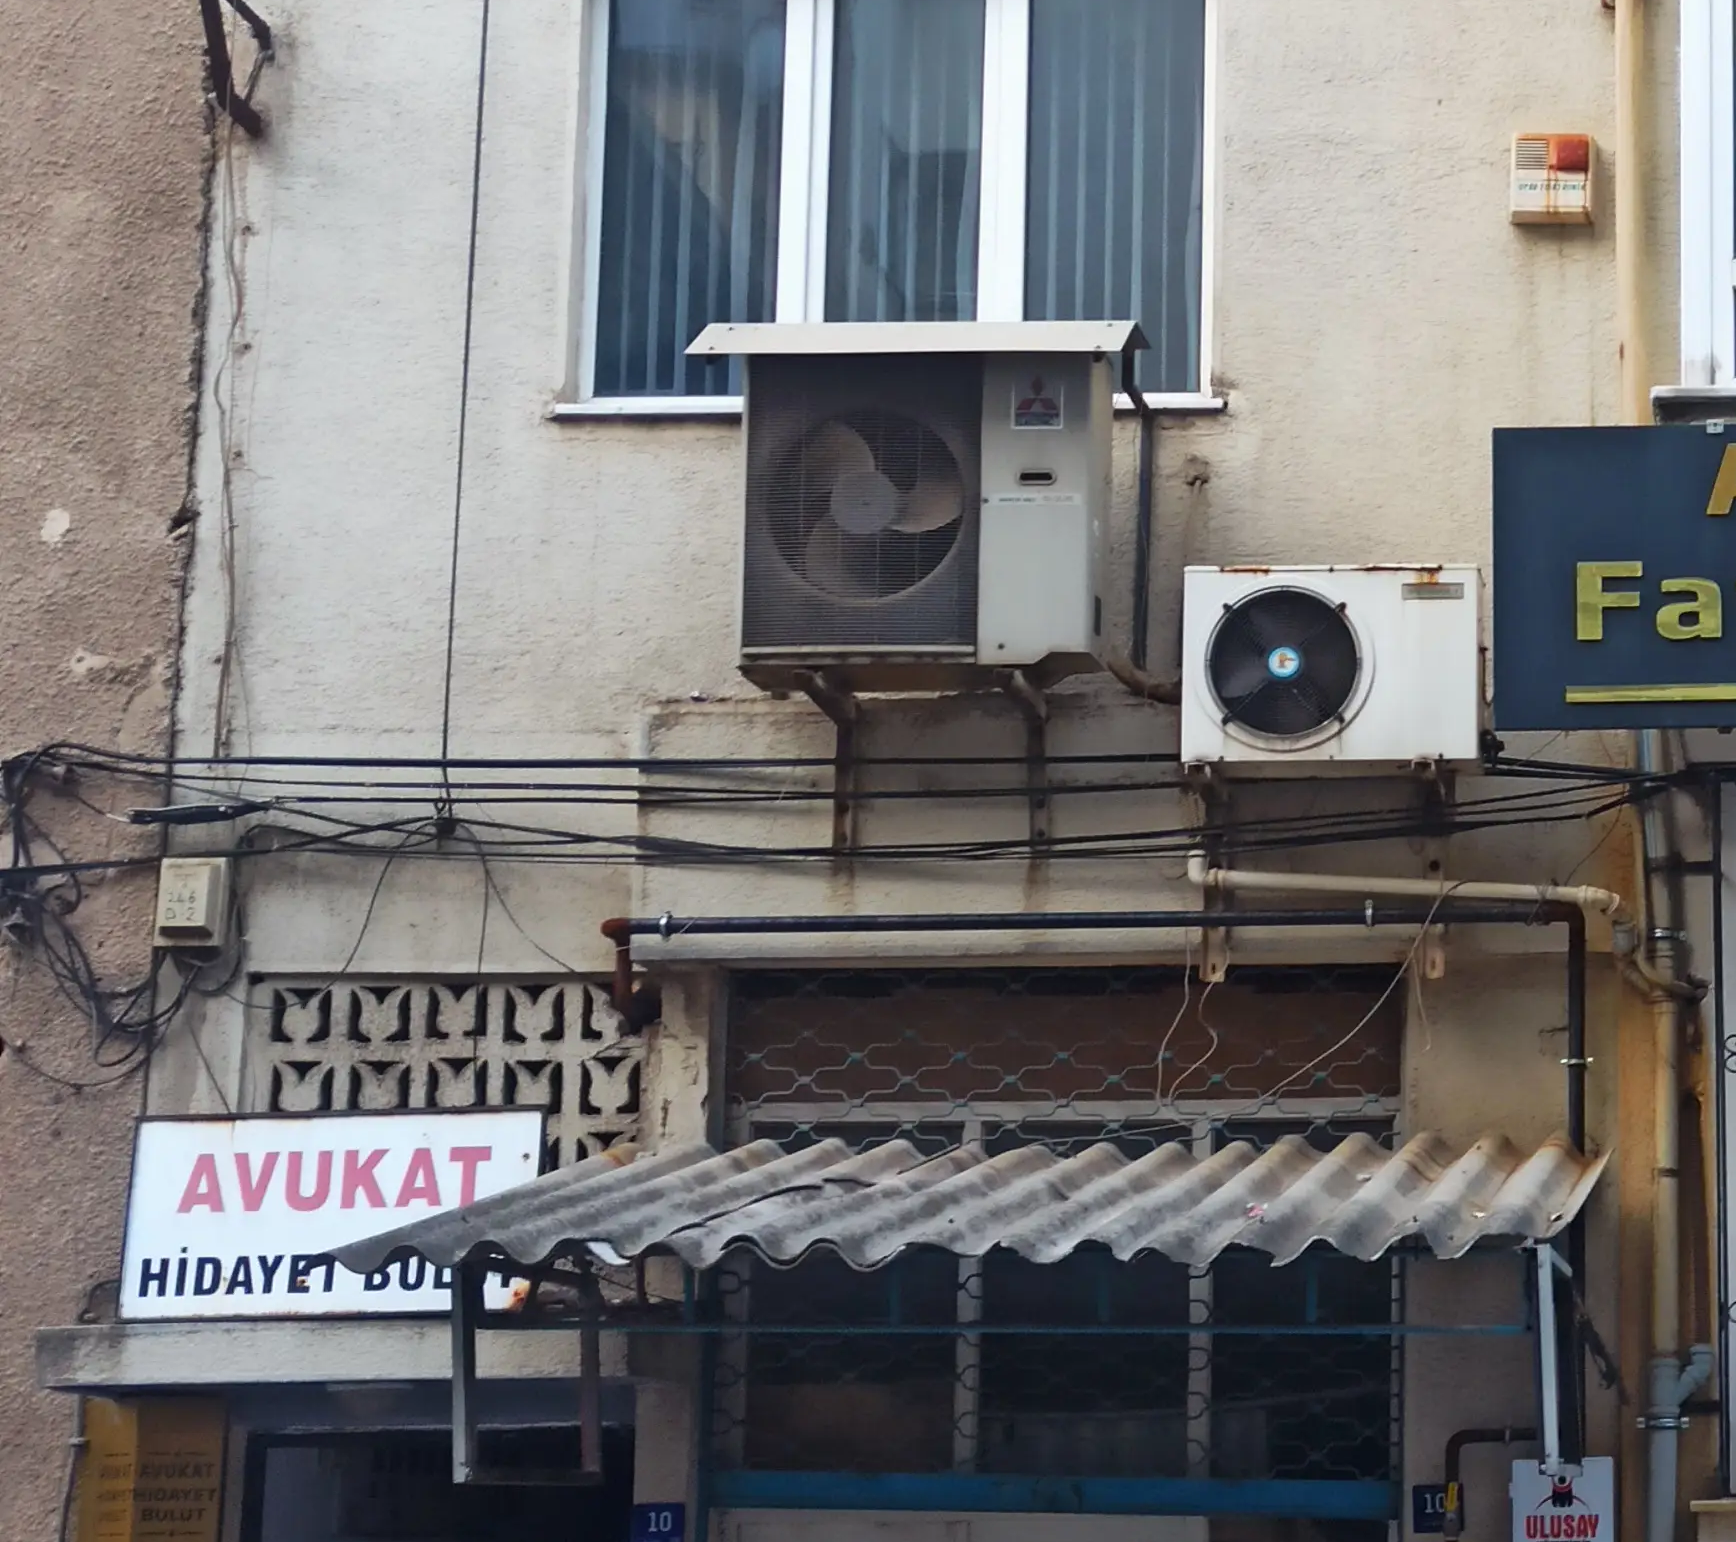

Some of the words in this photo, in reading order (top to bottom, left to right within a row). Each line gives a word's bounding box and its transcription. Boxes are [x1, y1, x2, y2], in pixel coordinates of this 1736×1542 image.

[176, 1145, 493, 1215] AVUKAT
[137, 1246, 338, 1299] HİDAYET
[138, 1462, 215, 1479] AVUKAT
[1423, 1492, 1447, 1513] 10
[139, 1508, 207, 1523] BULUT
[648, 1511, 672, 1532] 10
[1525, 1514, 1599, 1540] ULUSAY
